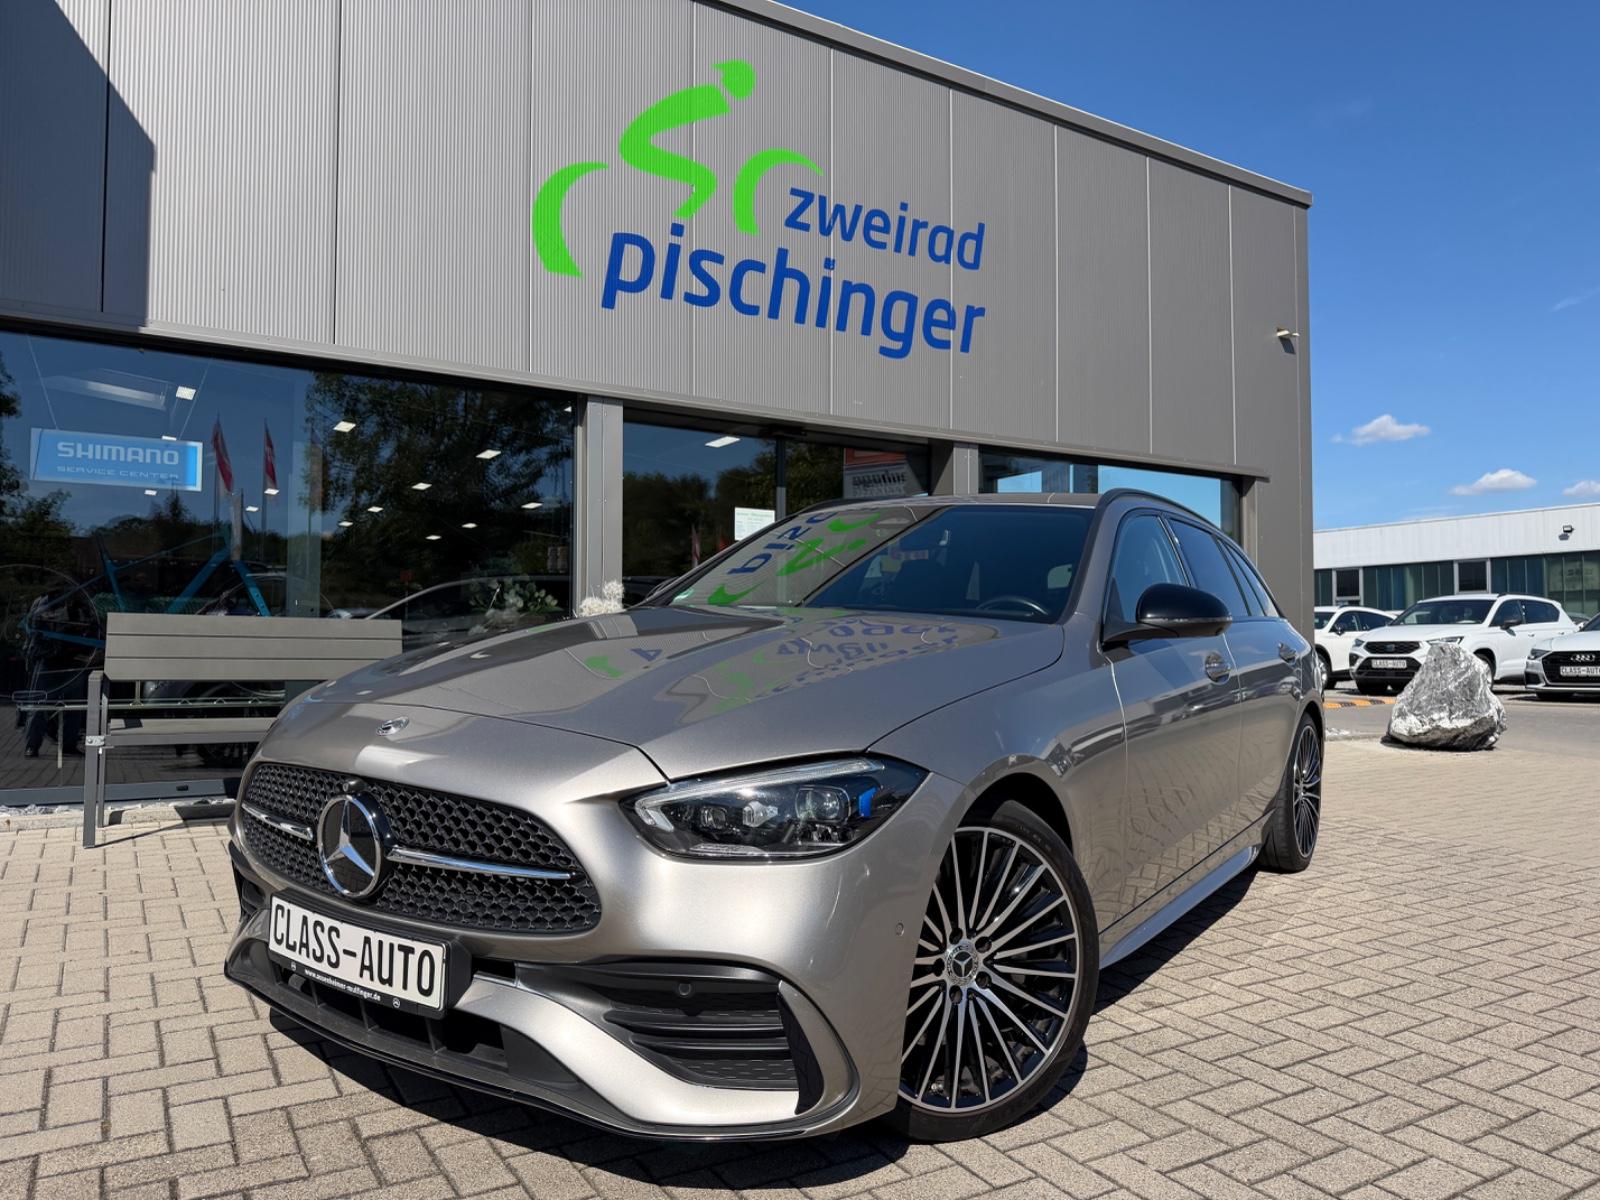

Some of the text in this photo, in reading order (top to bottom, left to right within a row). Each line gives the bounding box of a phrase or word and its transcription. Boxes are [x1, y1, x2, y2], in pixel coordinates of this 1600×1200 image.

[784, 187, 986, 271] zweirad
[601, 222, 987, 360] pischinger
[56, 441, 179, 465] SHIMANO
[57, 465, 179, 480] SERVICE CENTER
[1561, 666, 1600, 675] CLASS-AUT
[273, 903, 436, 997] CLASS-AUTO
